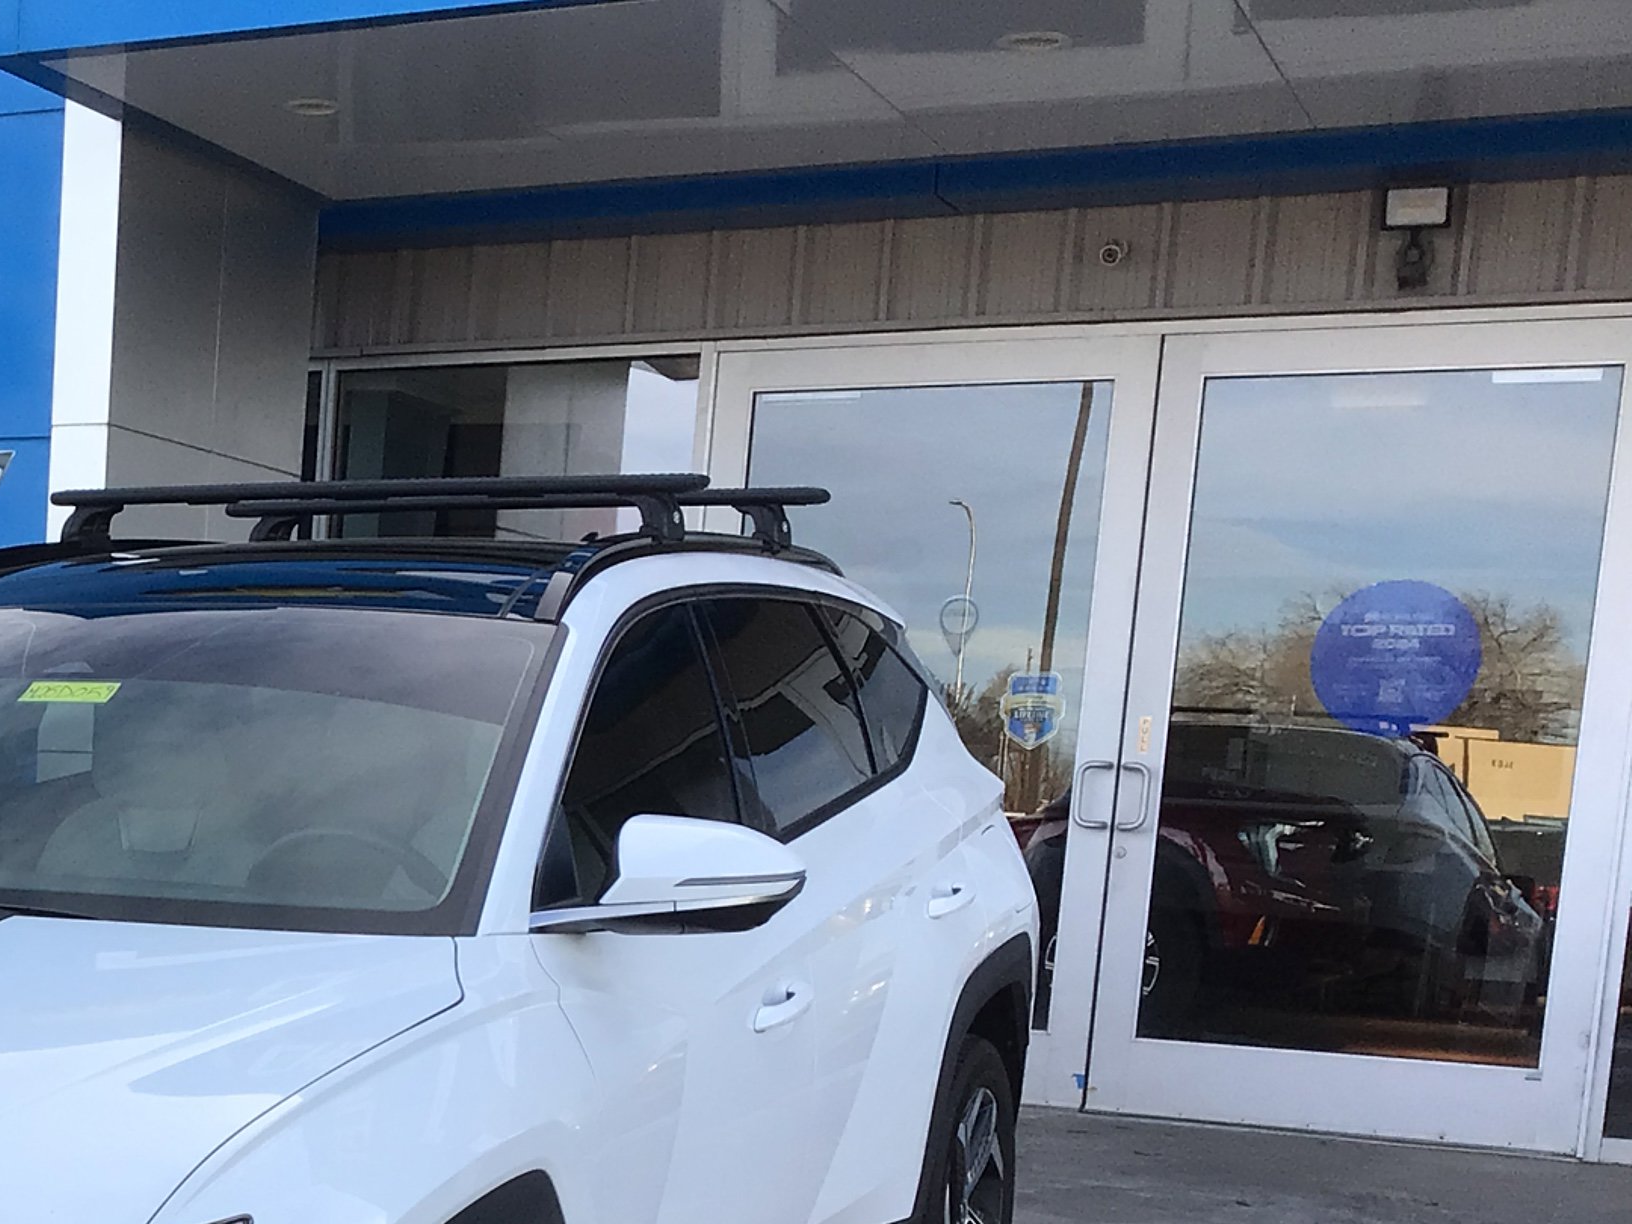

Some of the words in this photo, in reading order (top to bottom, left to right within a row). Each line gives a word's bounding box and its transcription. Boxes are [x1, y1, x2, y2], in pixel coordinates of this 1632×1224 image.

[1340, 623, 1386, 637] TOP
[1388, 623, 1456, 637] RATED
[1140, 718, 1150, 752] PULL
